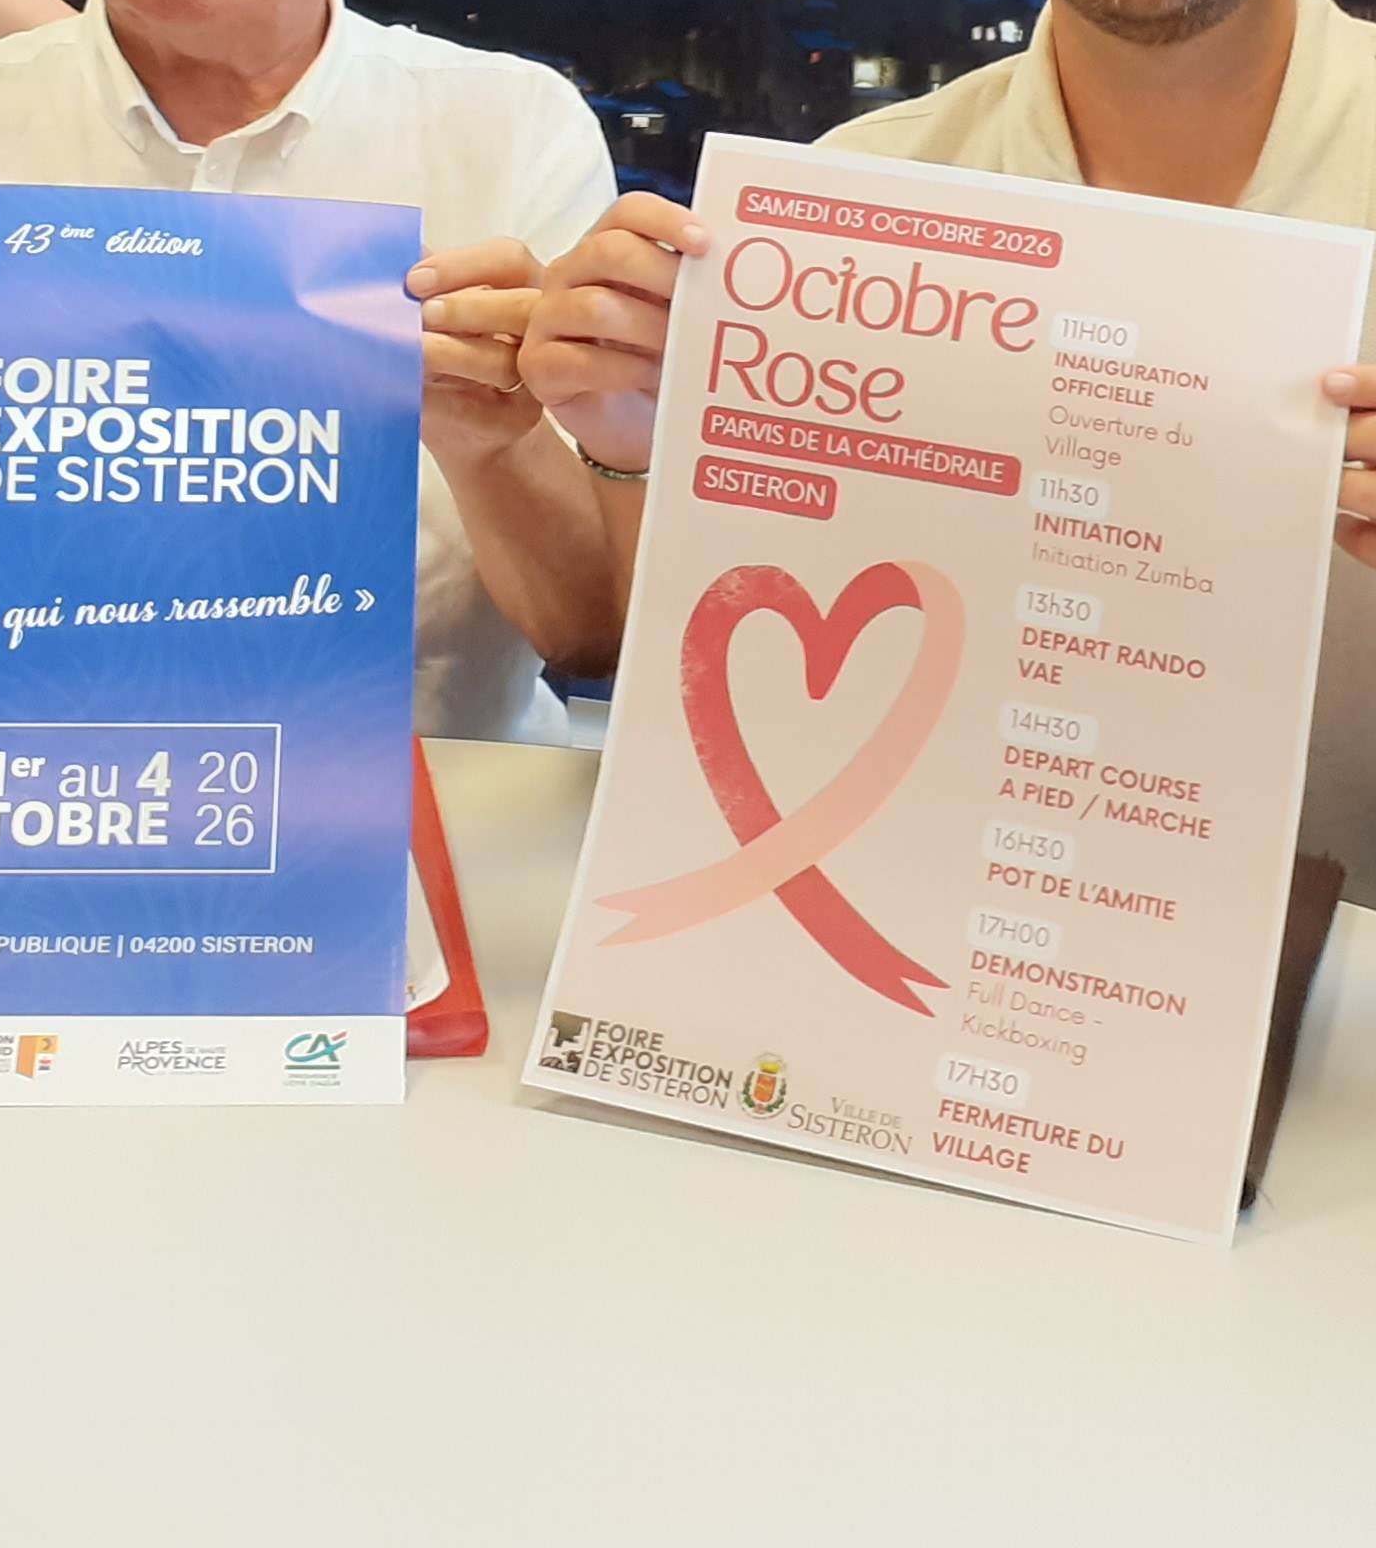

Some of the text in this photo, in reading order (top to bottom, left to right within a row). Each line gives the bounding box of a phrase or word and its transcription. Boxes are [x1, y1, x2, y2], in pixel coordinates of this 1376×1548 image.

[4, 223, 204, 257] 43 ème édition
[745, 193, 1053, 257] SAMEDI 03 OCTOBRE 2026
[723, 236, 1039, 353] Octobre
[1062, 318, 1128, 347] 11H00
[707, 320, 905, 423] Rose
[1051, 377, 1155, 407] OFFICIELLE
[1055, 352, 1209, 391] INAUGURATION
[1049, 405, 1193, 446] Ouverture du
[709, 415, 1005, 483] PARVIS DE LA CATHÉDRALE
[1045, 435, 1122, 469] Village
[56, 456, 339, 503] SISTERON
[703, 466, 828, 506] SISTERON
[1040, 477, 1099, 506] 11h30
[1034, 512, 1163, 553] INITIATION
[1032, 542, 1213, 594] Initiation Zumba
[2, 597, 66, 650] qui
[74, 597, 159, 626] nous
[164, 573, 343, 621] rassemble
[1027, 591, 1091, 622] 13h30
[1019, 658, 1064, 684] VAE
[1021, 626, 1206, 679] DEPART RANDO
[1012, 708, 1080, 741] 14H30
[58, 765, 119, 797] au
[135, 751, 172, 796] 4
[196, 752, 259, 794] 20
[1004, 745, 1201, 803] DEPART COURSE
[193, 804, 255, 846] 26
[999, 778, 1212, 839] A PIED / MARCHE
[994, 827, 1064, 861] 16H30
[987, 862, 1176, 921] POT DE L'AMITIE
[130, 936, 196, 953] 04200
[201, 936, 313, 954] SISTERON
[979, 913, 1050, 947] 17H00
[967, 982, 1005, 1007] Full
[1010, 991, 1086, 1025] Dance
[970, 950, 1187, 1016] DEMONSTRATION
[120, 1041, 182, 1054] ALPES
[593, 1020, 664, 1052] FOIRE
[961, 1013, 1088, 1066] Kickboxing
[117, 1056, 226, 1074] PROVENCE
[583, 1060, 729, 1109] DE SISTERON
[590, 1041, 733, 1090] EXPOSITION
[947, 1060, 1018, 1095] 17H30
[787, 1104, 913, 1155] SISTERON
[880, 1111, 902, 1129] DE
[938, 1099, 1125, 1159] FERMETURE DU
[932, 1131, 1031, 1174] VILLAGE
